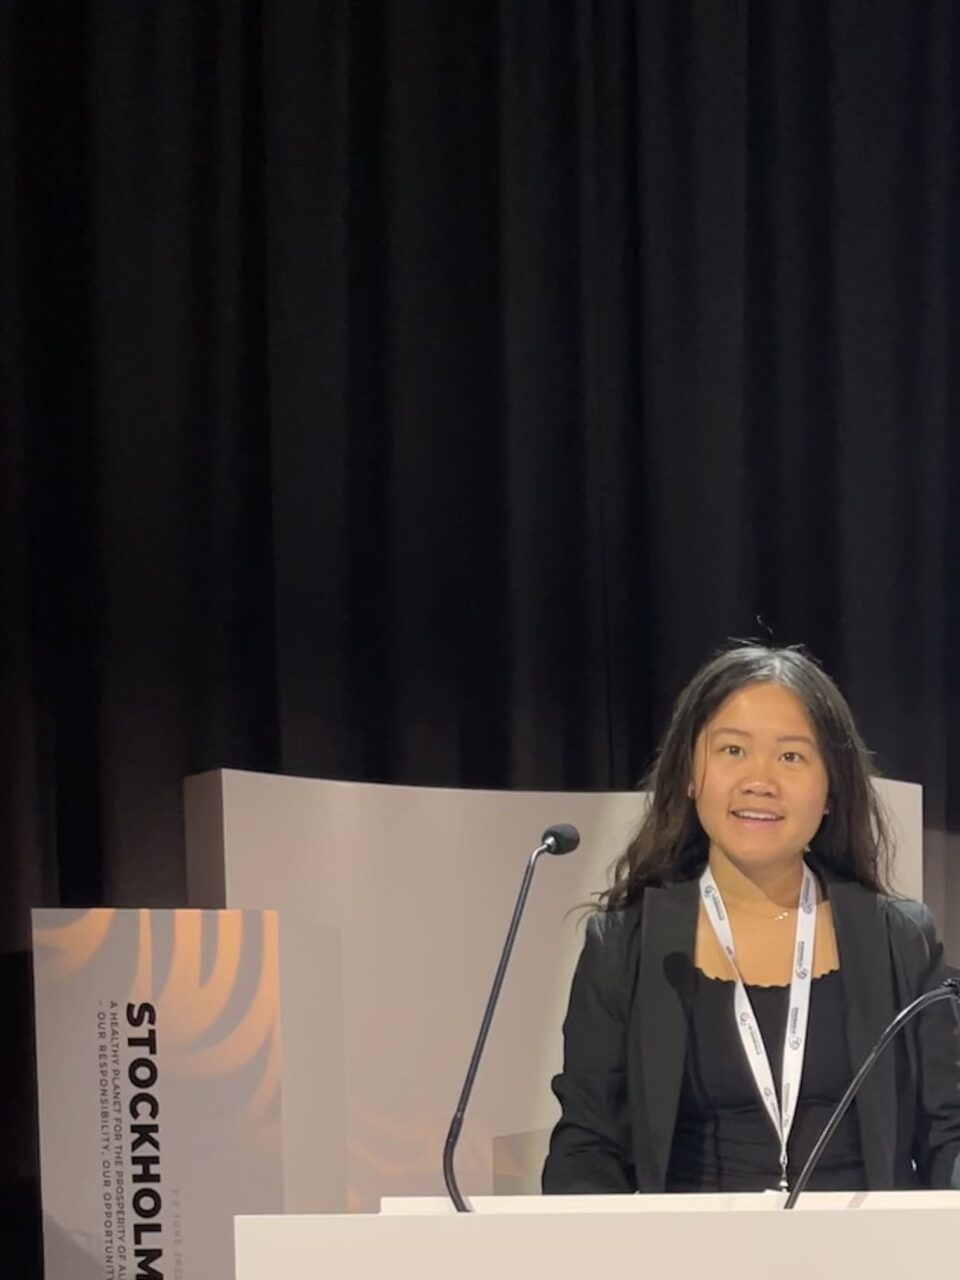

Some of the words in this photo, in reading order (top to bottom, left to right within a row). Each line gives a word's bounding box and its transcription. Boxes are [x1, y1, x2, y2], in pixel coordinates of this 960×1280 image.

[110, 1001, 118, 1009] A
[110, 1012, 120, 1065] HEALTHY
[97, 1011, 107, 1039] OUR
[102, 1160, 112, 1188] OUR
[112, 1068, 122, 1114] PLANET
[114, 1117, 123, 1141] FOR
[114, 1145, 124, 1167] THE
[115, 1170, 126, 1242] PROSPERITY
[117, 1245, 127, 1260] OF
